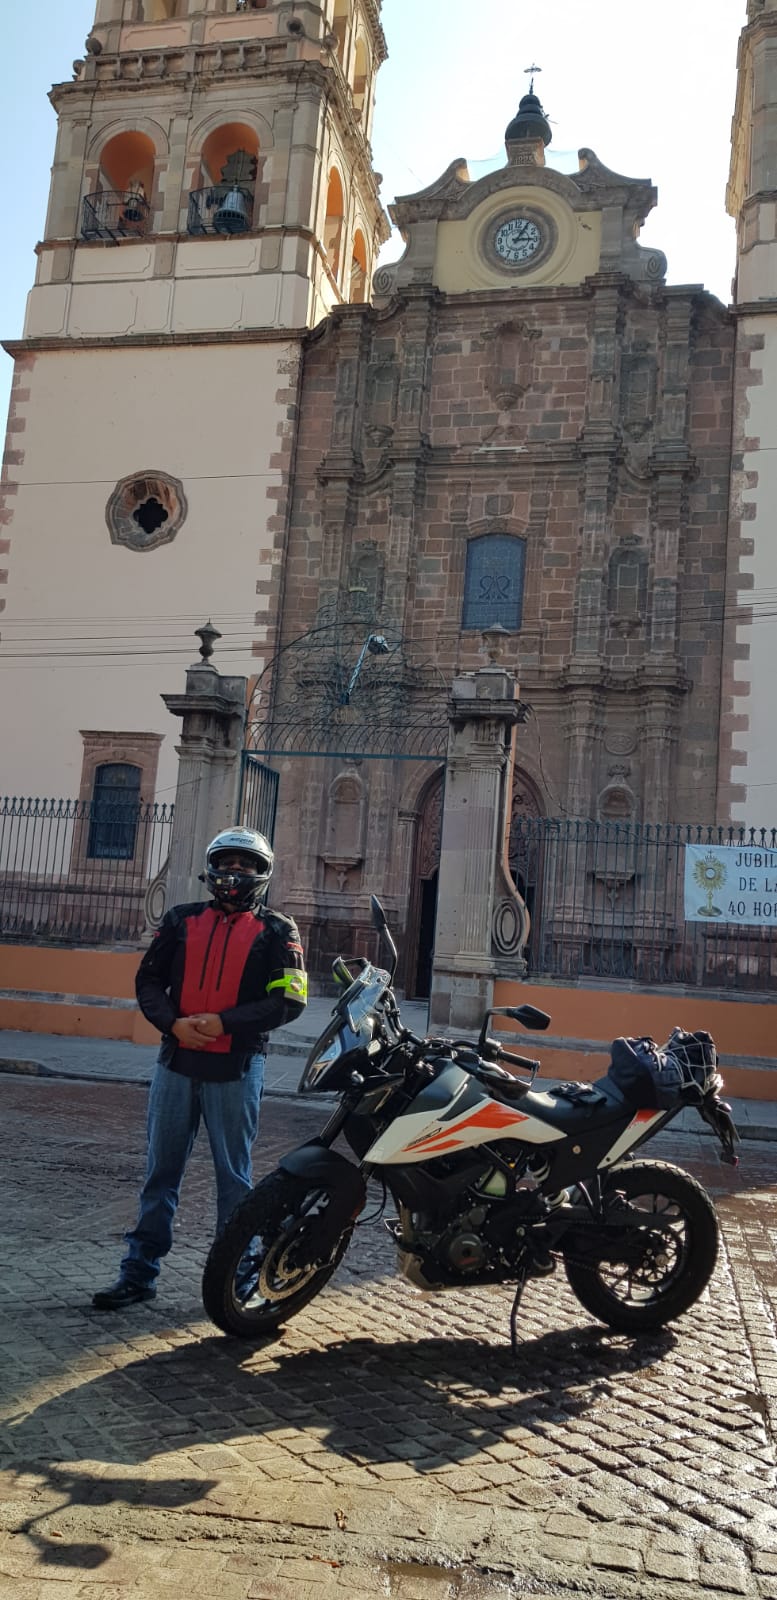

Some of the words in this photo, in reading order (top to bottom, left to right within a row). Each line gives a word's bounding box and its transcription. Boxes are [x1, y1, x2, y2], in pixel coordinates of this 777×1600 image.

[515, 220, 522, 228] 12
[735, 853, 777, 868] JUBIL
[738, 876, 757, 892] DE
[764, 877, 777, 892] L
[728, 900, 746, 916] 40
